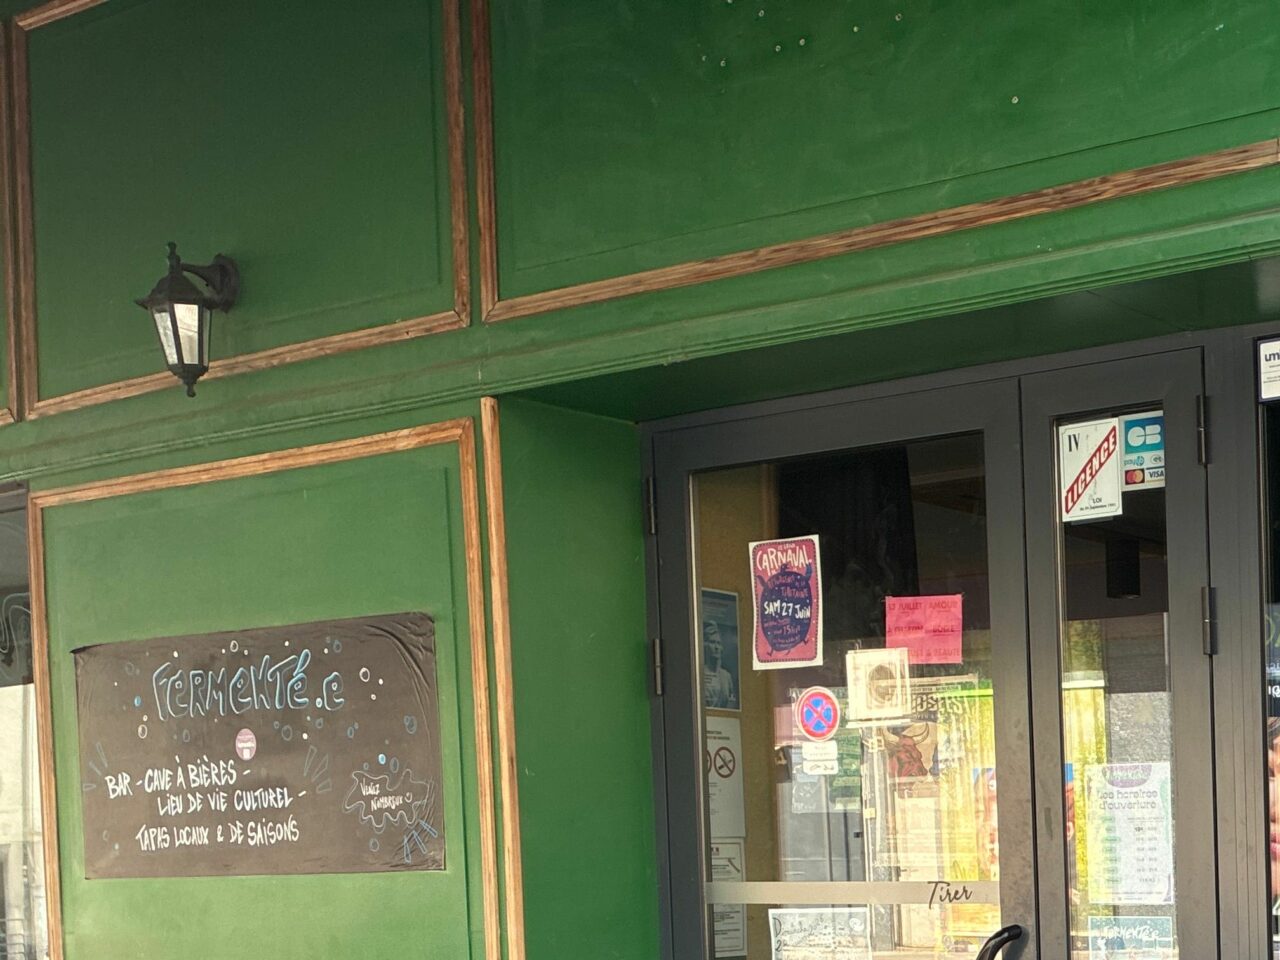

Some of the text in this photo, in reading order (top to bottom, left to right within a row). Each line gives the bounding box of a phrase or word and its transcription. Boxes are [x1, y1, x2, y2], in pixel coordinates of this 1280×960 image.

[1068, 432, 1080, 452] IV
[1065, 427, 1116, 513] LICENCE
[1148, 469, 1165, 479] VISA
[763, 600, 781, 617] SAM
[781, 602, 794, 617] 27
[104, 770, 134, 799] BAR
[144, 768, 173, 793] CAVE
[175, 754, 186, 790] À
[188, 754, 237, 790] BIÈRES
[186, 792, 203, 813] DE
[233, 786, 294, 812] CULTUREL
[135, 823, 170, 852] TAPAS
[173, 825, 209, 848] LOCAUX
[228, 821, 245, 845] DE
[928, 881, 973, 909] Tirer
